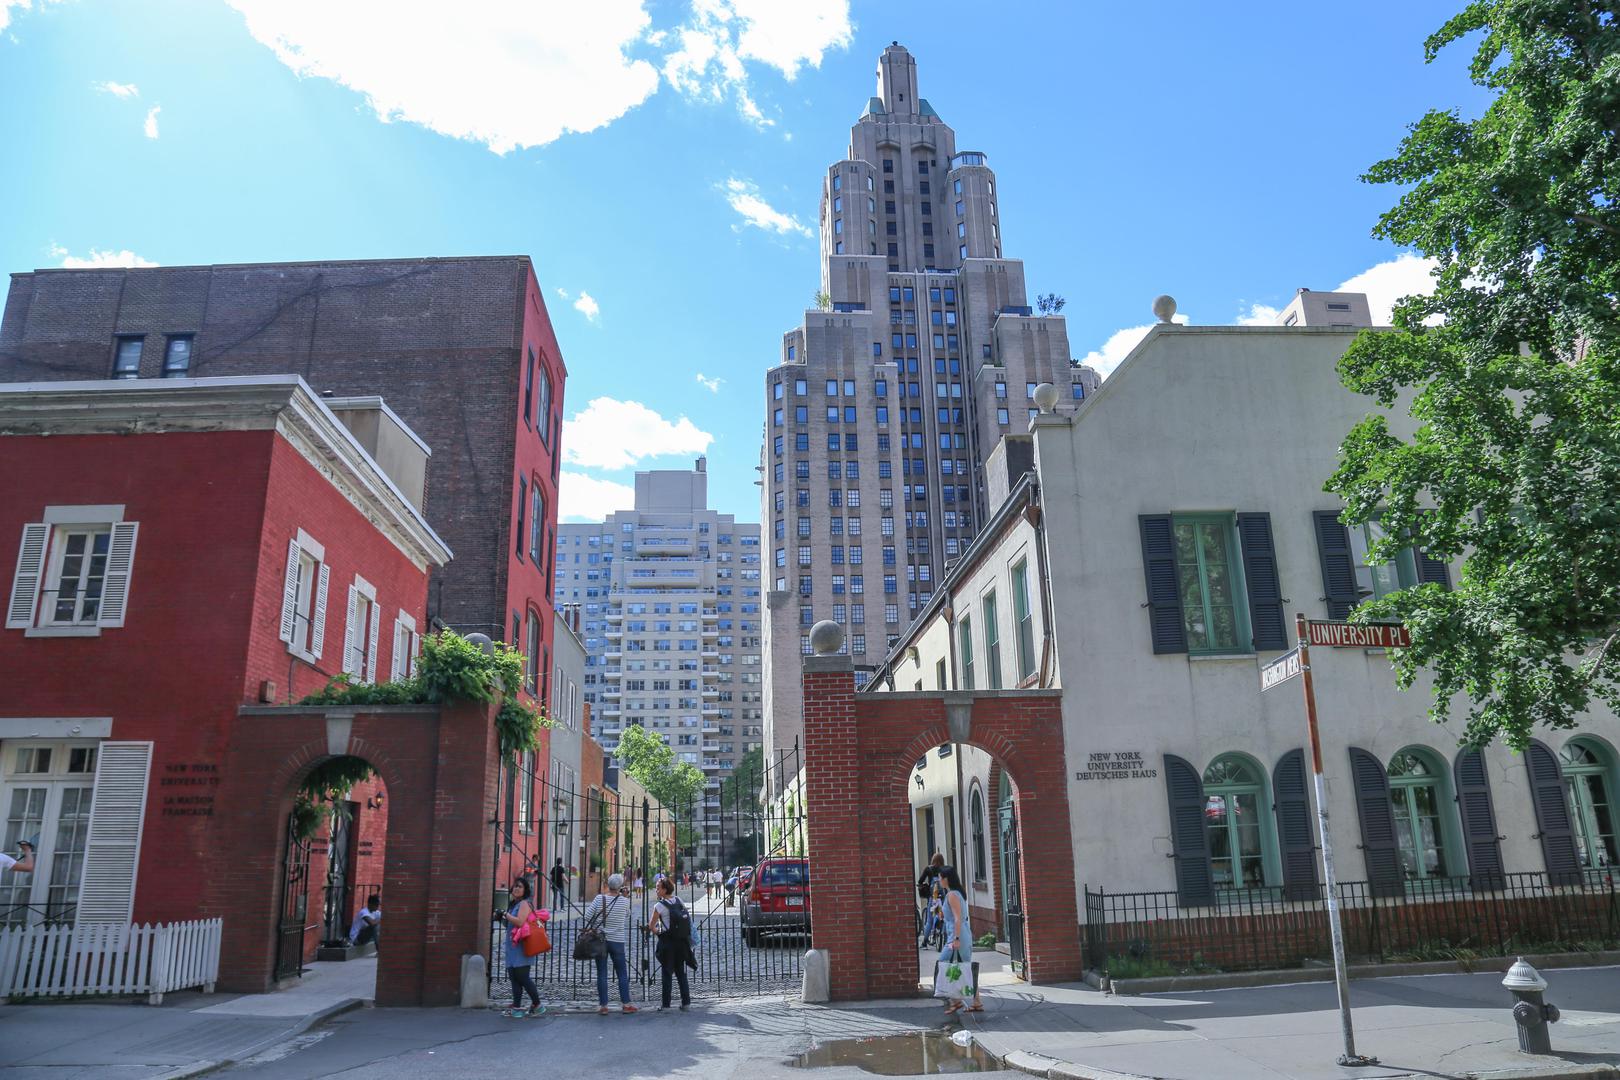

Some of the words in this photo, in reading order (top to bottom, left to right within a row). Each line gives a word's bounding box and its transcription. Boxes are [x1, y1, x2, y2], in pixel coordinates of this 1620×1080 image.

[1311, 624, 1383, 645] UNIVERSITY
[1389, 626, 1406, 645] PL
[1089, 753, 1111, 761] NEW
[1114, 752, 1142, 760] YORK
[165, 764, 187, 773] NEW
[191, 764, 218, 773] YORK
[1087, 761, 1144, 771] UNIVERSITY
[1076, 771, 1129, 781] DEUTSCHES
[1132, 769, 1157, 778] HAUS
